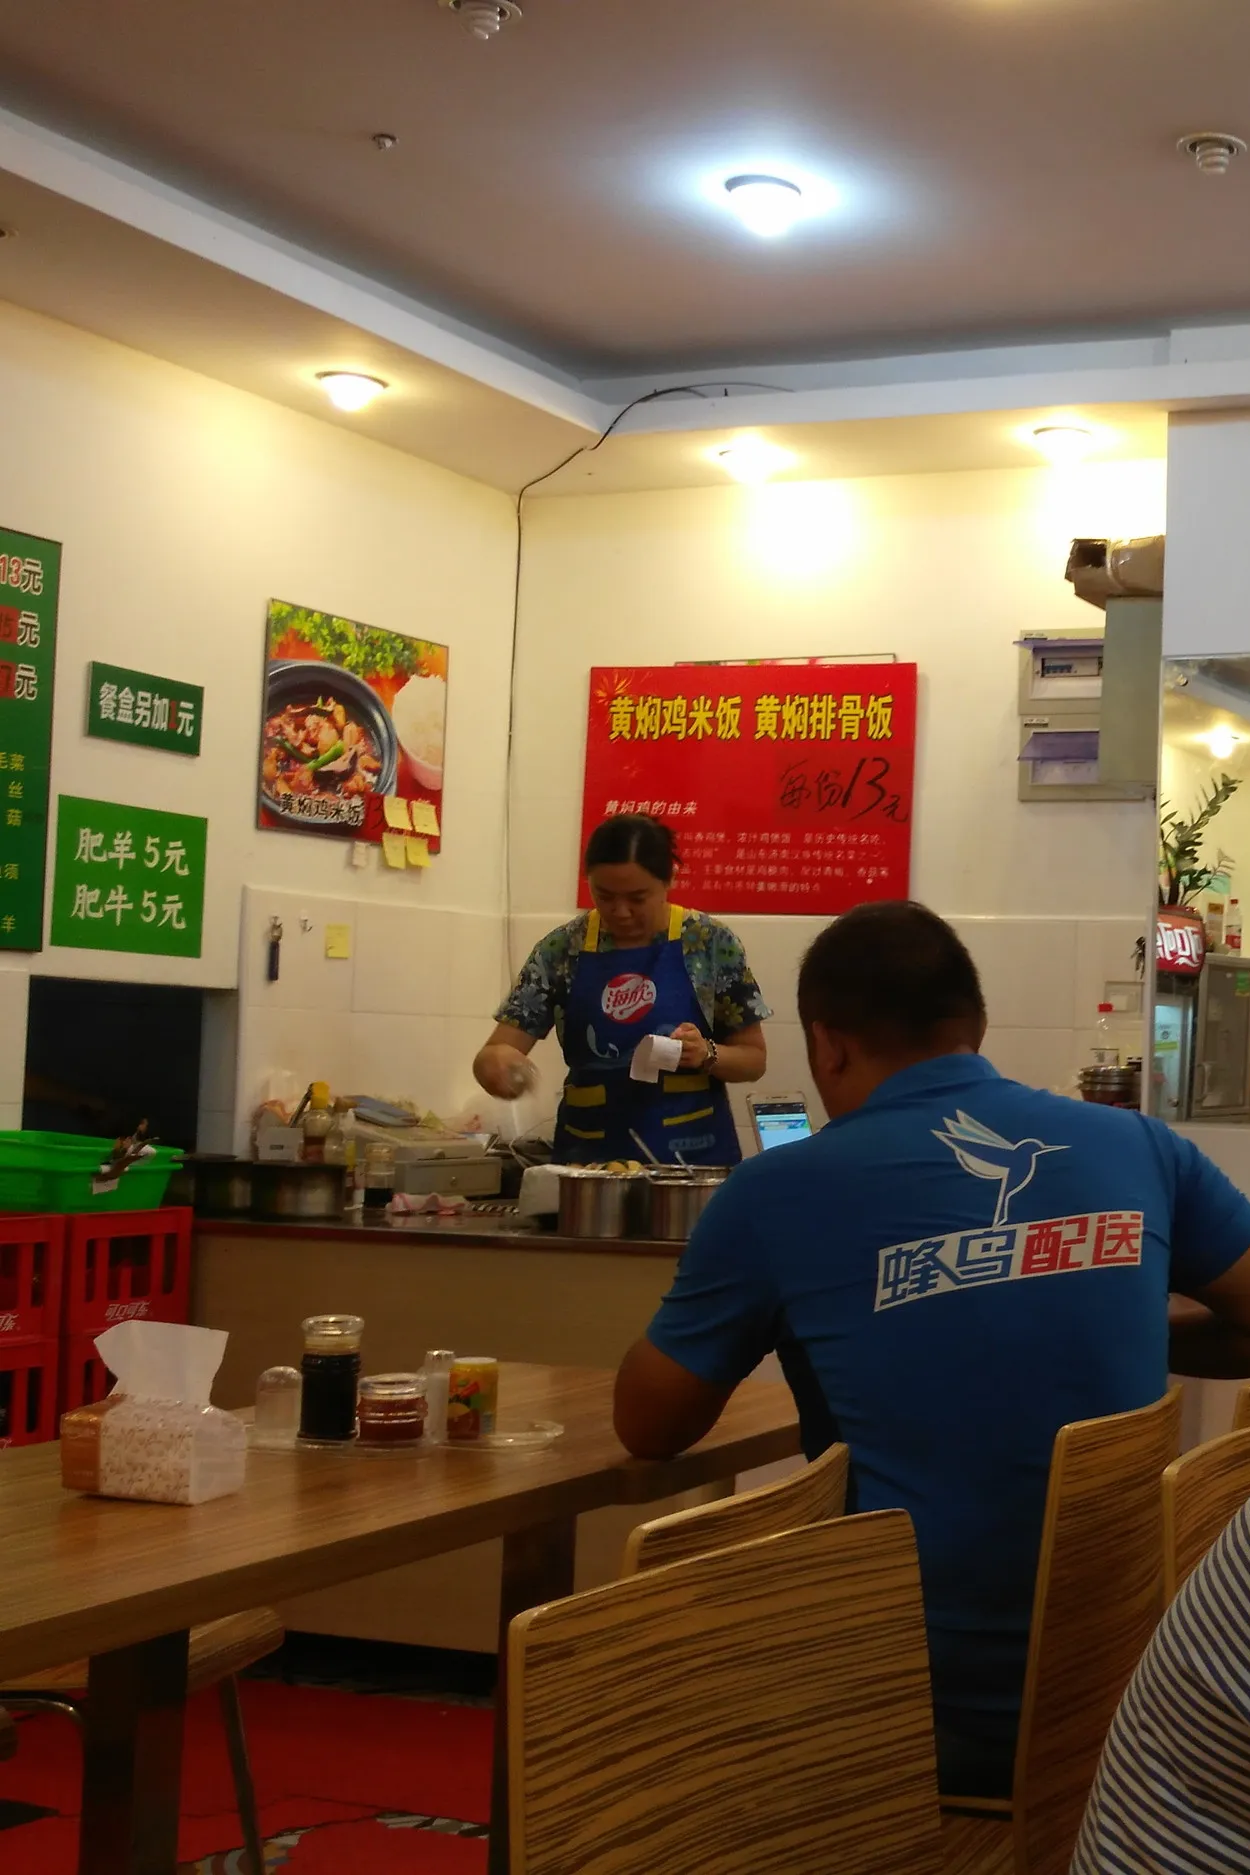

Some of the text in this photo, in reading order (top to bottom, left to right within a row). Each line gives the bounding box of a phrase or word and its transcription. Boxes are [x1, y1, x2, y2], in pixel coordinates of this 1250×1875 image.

[99, 681, 195, 737] 餐盒另加1元
[608, 694, 893, 741] 黄焖鸡米饭 黄焖排骨饭
[74, 827, 190, 876] 肥羊 5元
[71, 884, 187, 930] 肥牛 5元
[876, 1212, 1143, 1309] 蜂鸟配送
